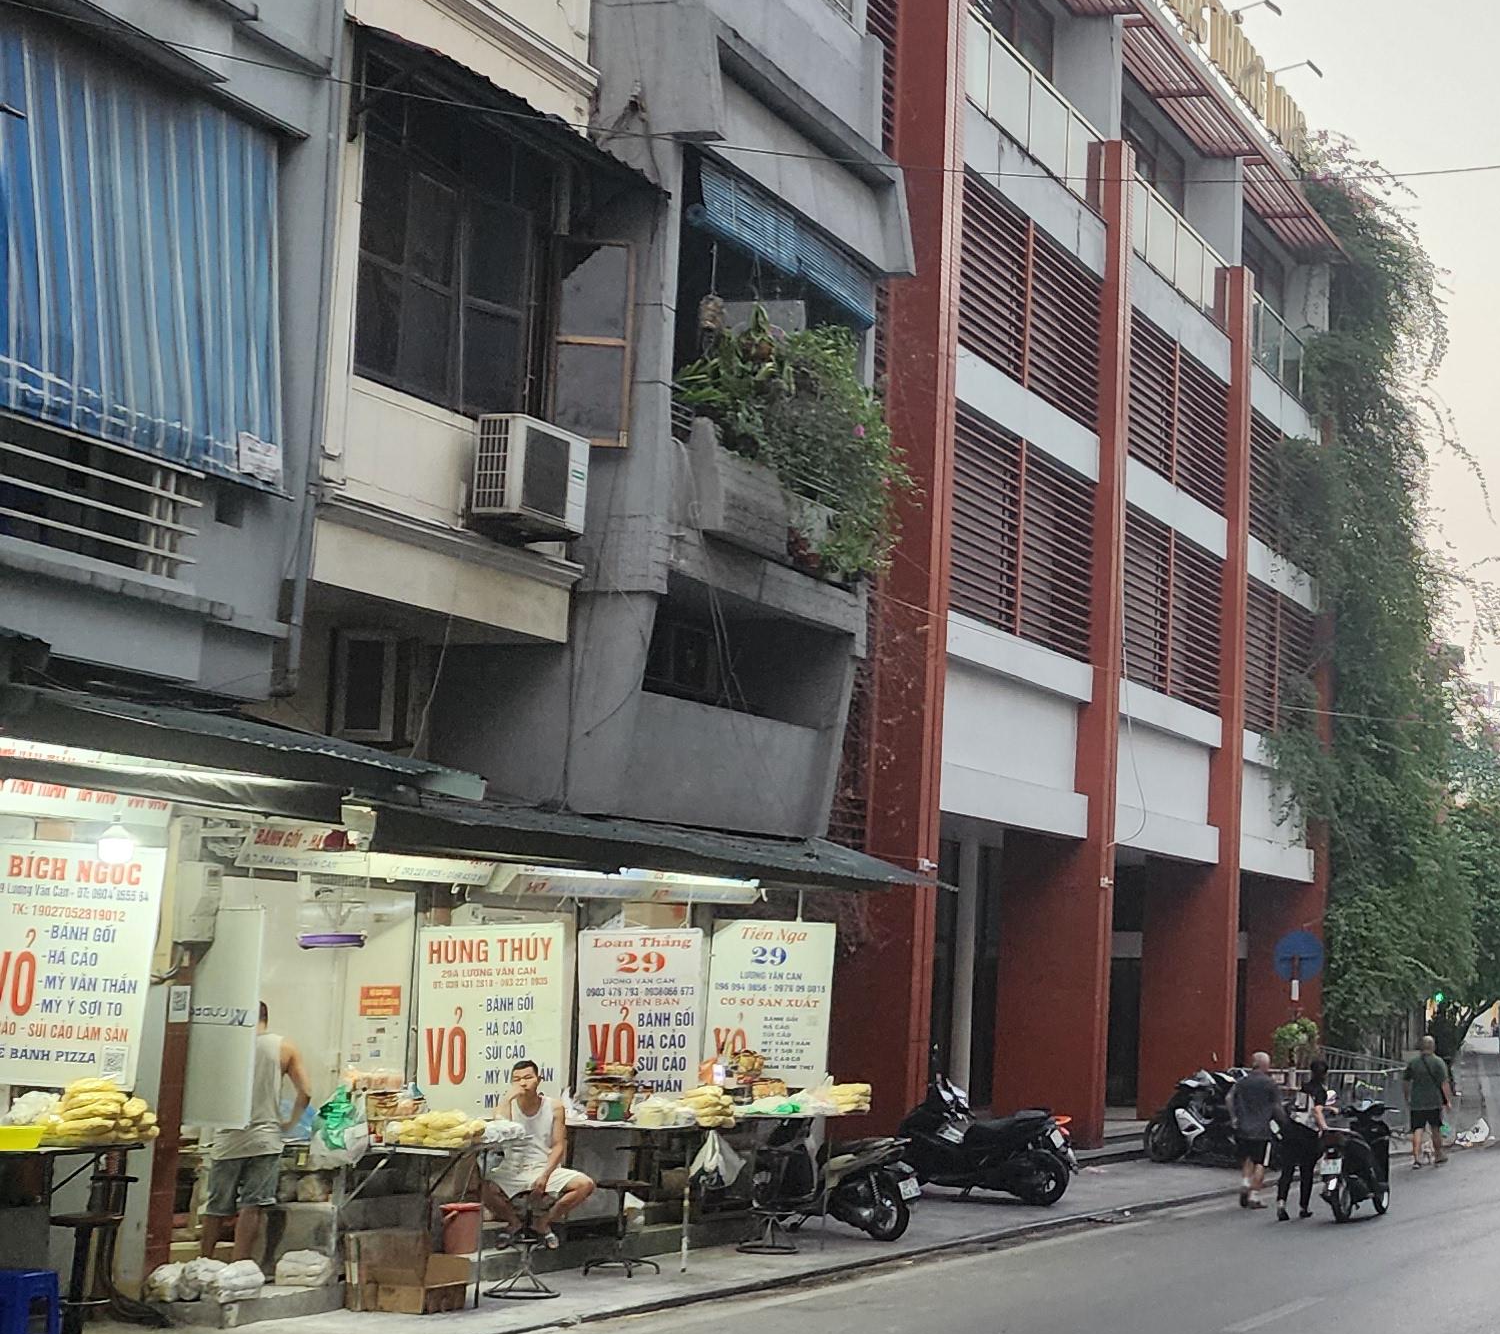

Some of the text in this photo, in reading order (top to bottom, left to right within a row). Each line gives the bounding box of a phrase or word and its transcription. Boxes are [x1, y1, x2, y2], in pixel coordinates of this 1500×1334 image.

[7, 850, 68, 882] BÍCH
[93, 924, 117, 944] GỐI
[593, 937, 634, 949] Loan
[428, 932, 553, 965] HÙNG THÚY
[750, 945, 788, 967] 29
[616, 951, 666, 974] 29
[108, 1001, 123, 1017] TO
[486, 992, 534, 1012] BÁNH GỐI
[637, 1006, 695, 1028] BÁNH GỐI
[10, 1045, 97, 1064] BÁNH PIZZA
[425, 1006, 467, 1086] VỎ
